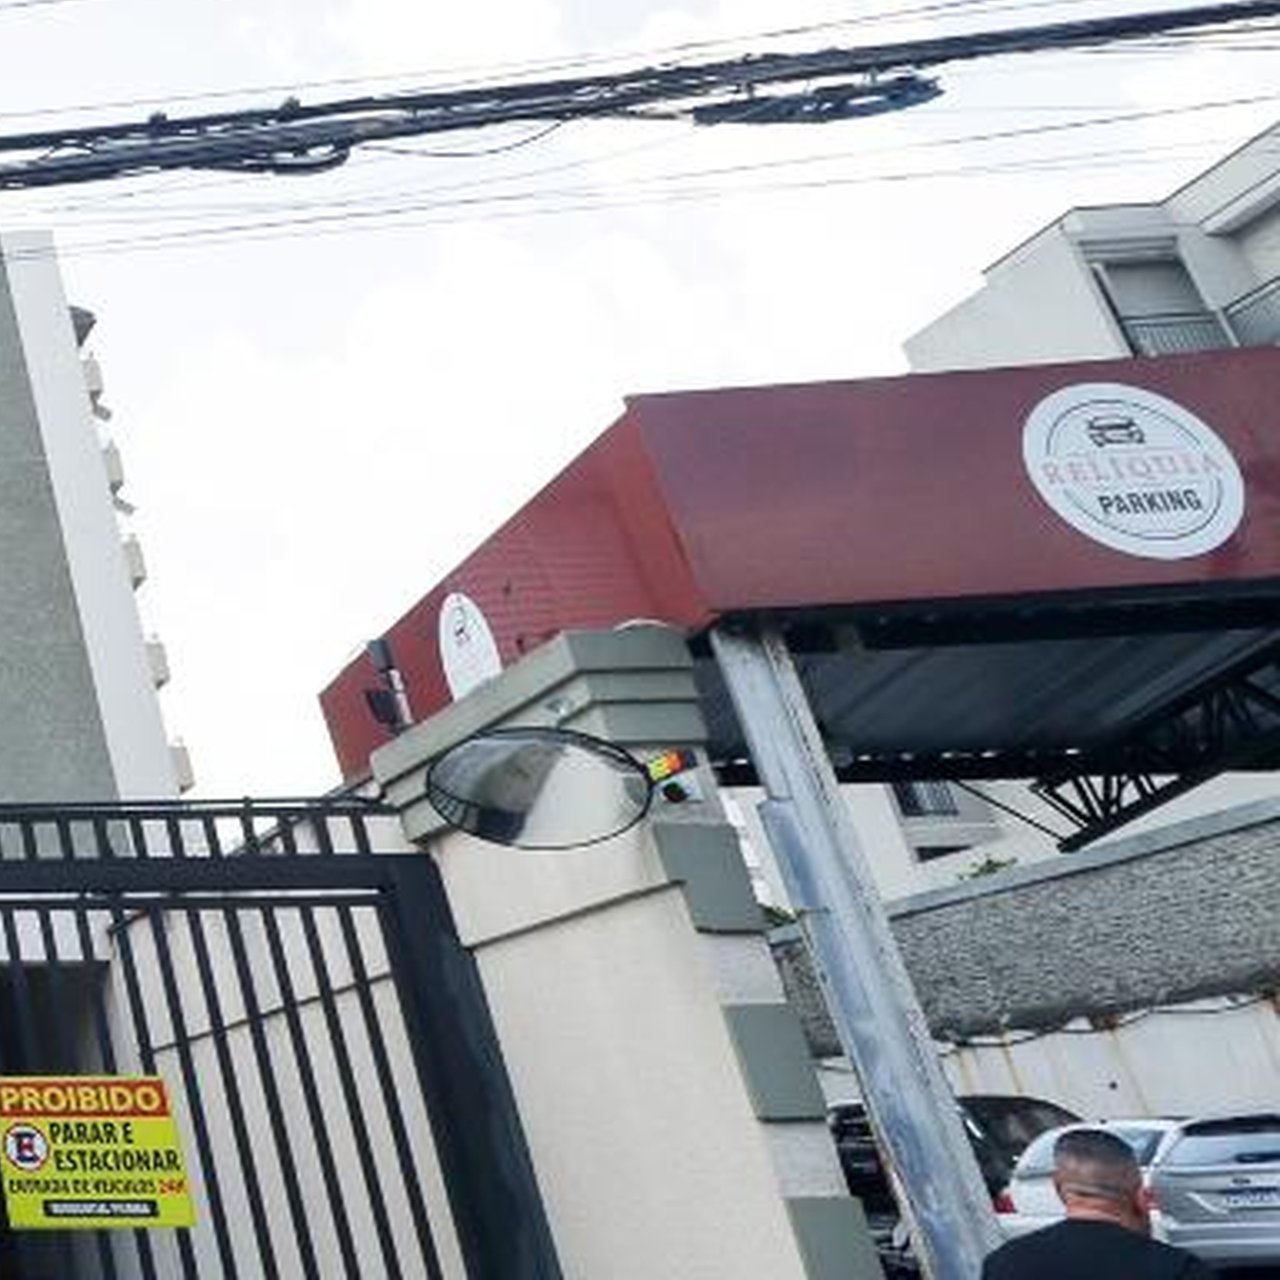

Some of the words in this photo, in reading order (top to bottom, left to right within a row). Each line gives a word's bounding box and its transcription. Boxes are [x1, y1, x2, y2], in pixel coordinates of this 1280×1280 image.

[1097, 488, 1202, 516] PARKING
[0, 1085, 161, 1112] PROIBIDO
[49, 1122, 119, 1145] PARAR
[122, 1122, 134, 1144] E
[53, 1149, 181, 1171] ESTACIONAR
